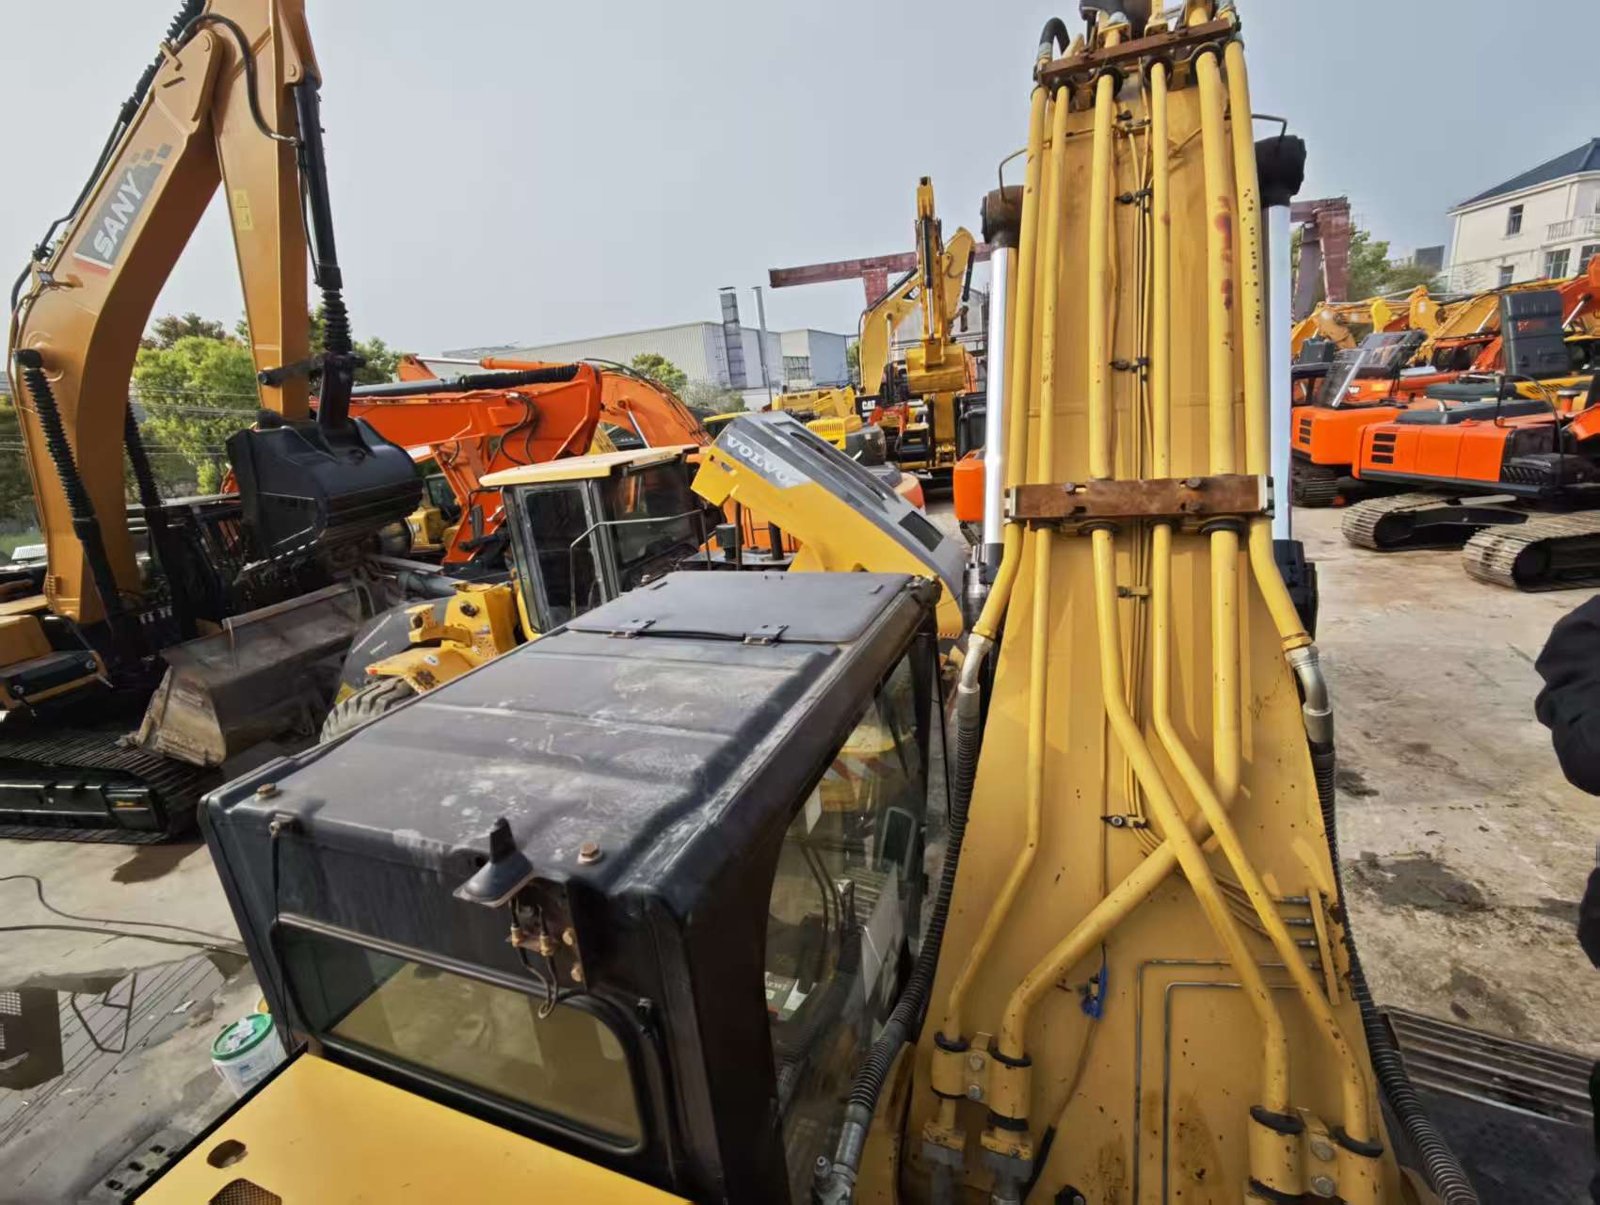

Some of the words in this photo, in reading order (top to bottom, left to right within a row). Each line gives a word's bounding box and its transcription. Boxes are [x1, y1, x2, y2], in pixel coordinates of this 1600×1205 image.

[93, 170, 142, 260] SANY
[862, 400, 875, 410] CAT
[727, 433, 788, 481] VOLVO
